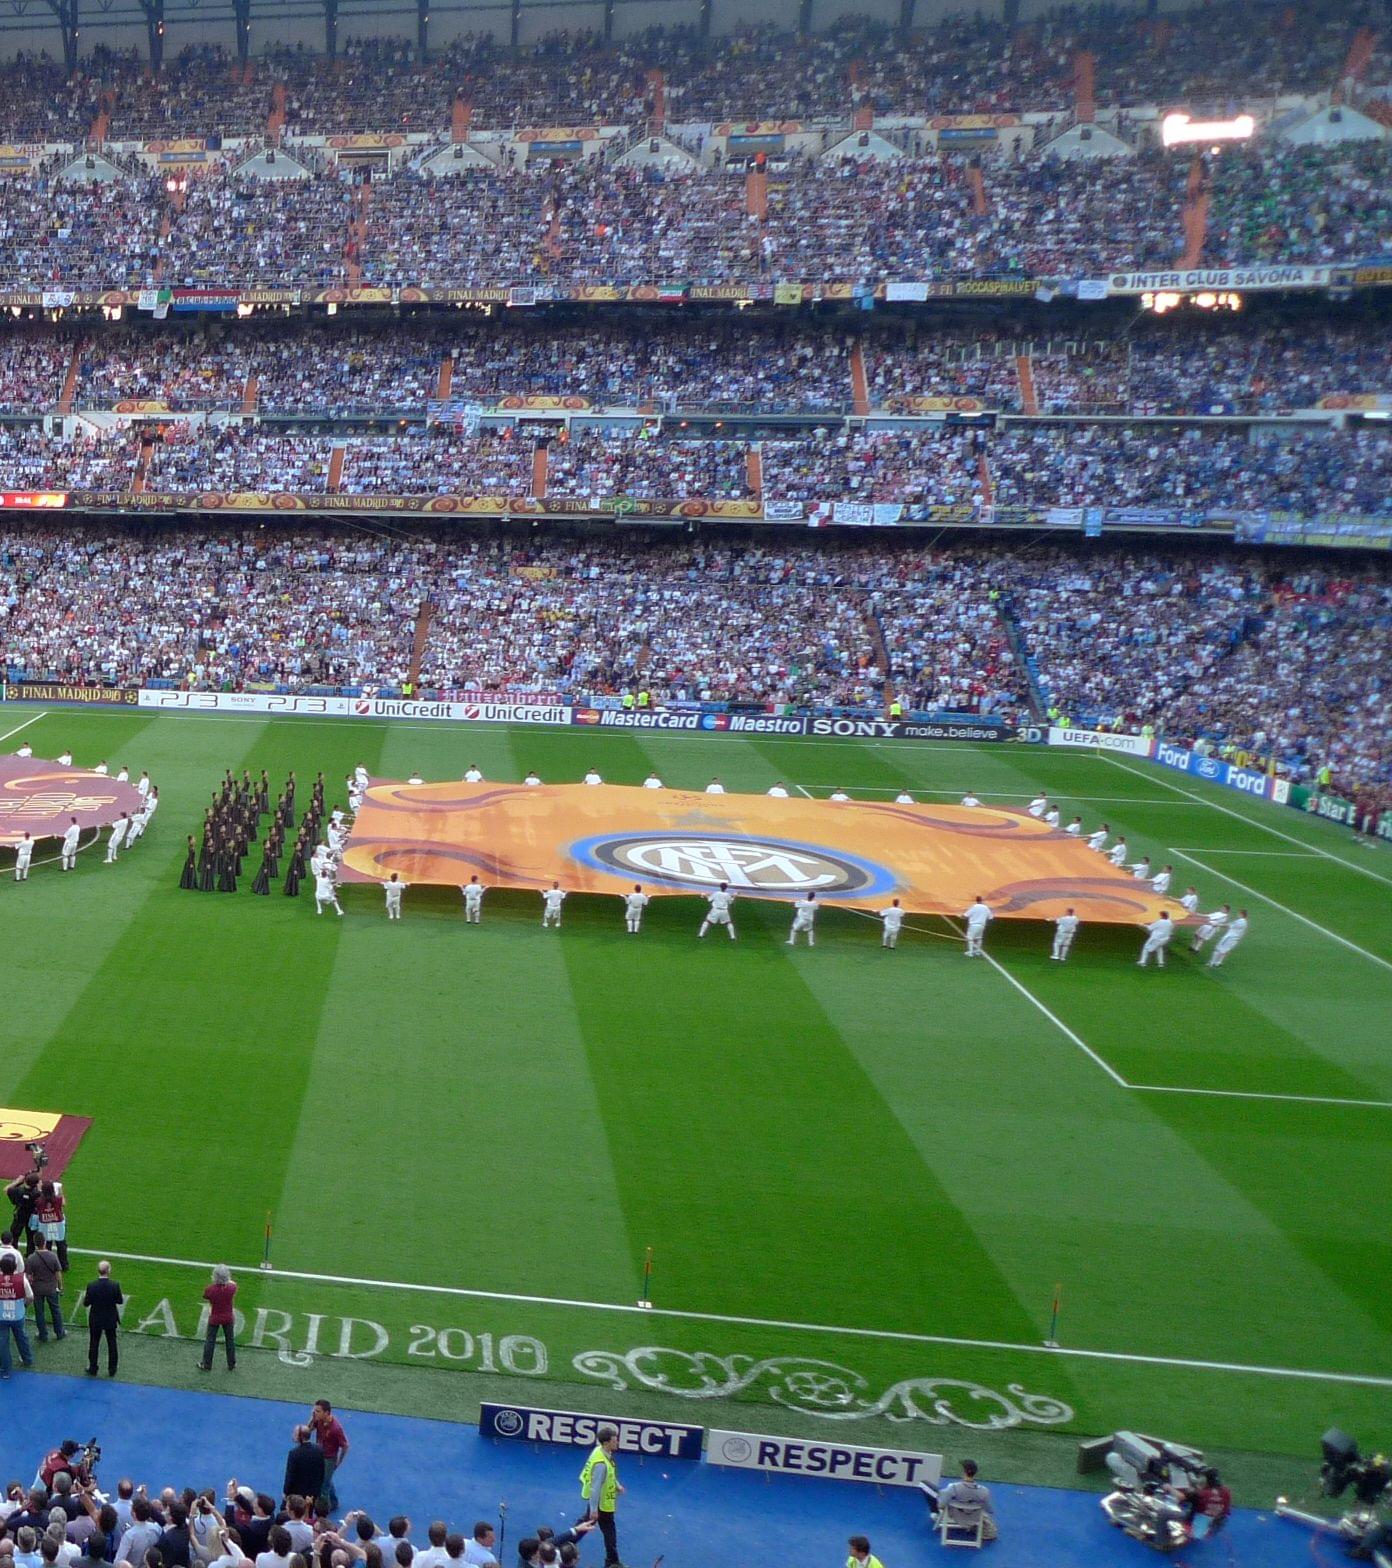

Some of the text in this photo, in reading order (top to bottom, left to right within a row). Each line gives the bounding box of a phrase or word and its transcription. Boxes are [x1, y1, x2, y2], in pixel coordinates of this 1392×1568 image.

[1130, 269, 1304, 289] INTER CLUB SAVONA
[324, 497, 351, 507] FINAL
[353, 497, 388, 509] MADRID
[22, 686, 122, 702] FINAL MADRID 2010
[160, 693, 219, 708] PS3
[230, 696, 257, 704] SONY
[267, 697, 328, 712] PS3
[374, 700, 452, 718] UniCredit
[484, 704, 565, 722] UniCredit
[601, 710, 699, 729] MasterCard
[729, 715, 802, 733] Maestro
[813, 720, 901, 737] SONY
[904, 725, 998, 740] make.believe
[1015, 727, 1042, 744] 3D
[1157, 742, 1190, 771] Ford
[1225, 765, 1266, 795] Ford
[1317, 797, 1346, 822] Star
[408, 1322, 550, 1376] 2010
[757, 1440, 924, 1483] RESPECT
